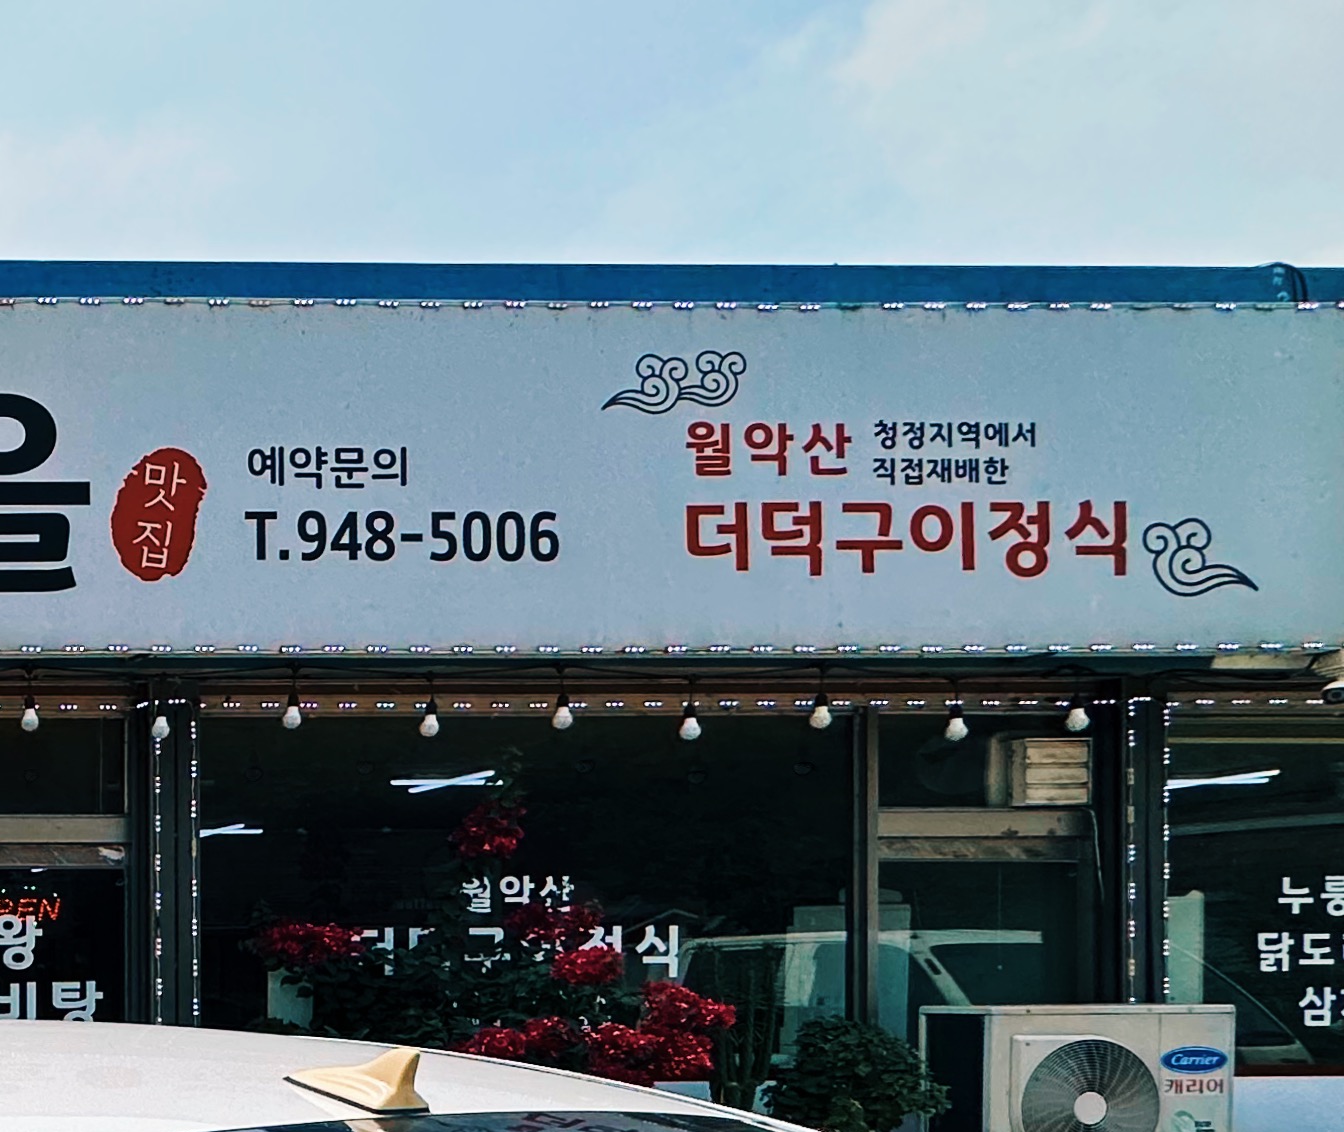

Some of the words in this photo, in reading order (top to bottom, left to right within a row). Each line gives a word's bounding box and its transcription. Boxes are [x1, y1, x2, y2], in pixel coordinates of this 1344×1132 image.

[684, 421, 852, 477] 월악산
[872, 418, 1038, 450] 청정지역에서
[246, 445, 409, 490] 예약문의
[872, 456, 1010, 487] 직접재배한
[131, 460, 188, 570] 맛집
[244, 510, 560, 563] T.948-5006
[684, 499, 1128, 579] 더덕구이정식
[1257, 931, 1344, 973] 닭도
[1298, 986, 1344, 1027] 삼
[1170, 1053, 1221, 1066] Carrier
[1163, 1078, 1224, 1095] 캐리어
